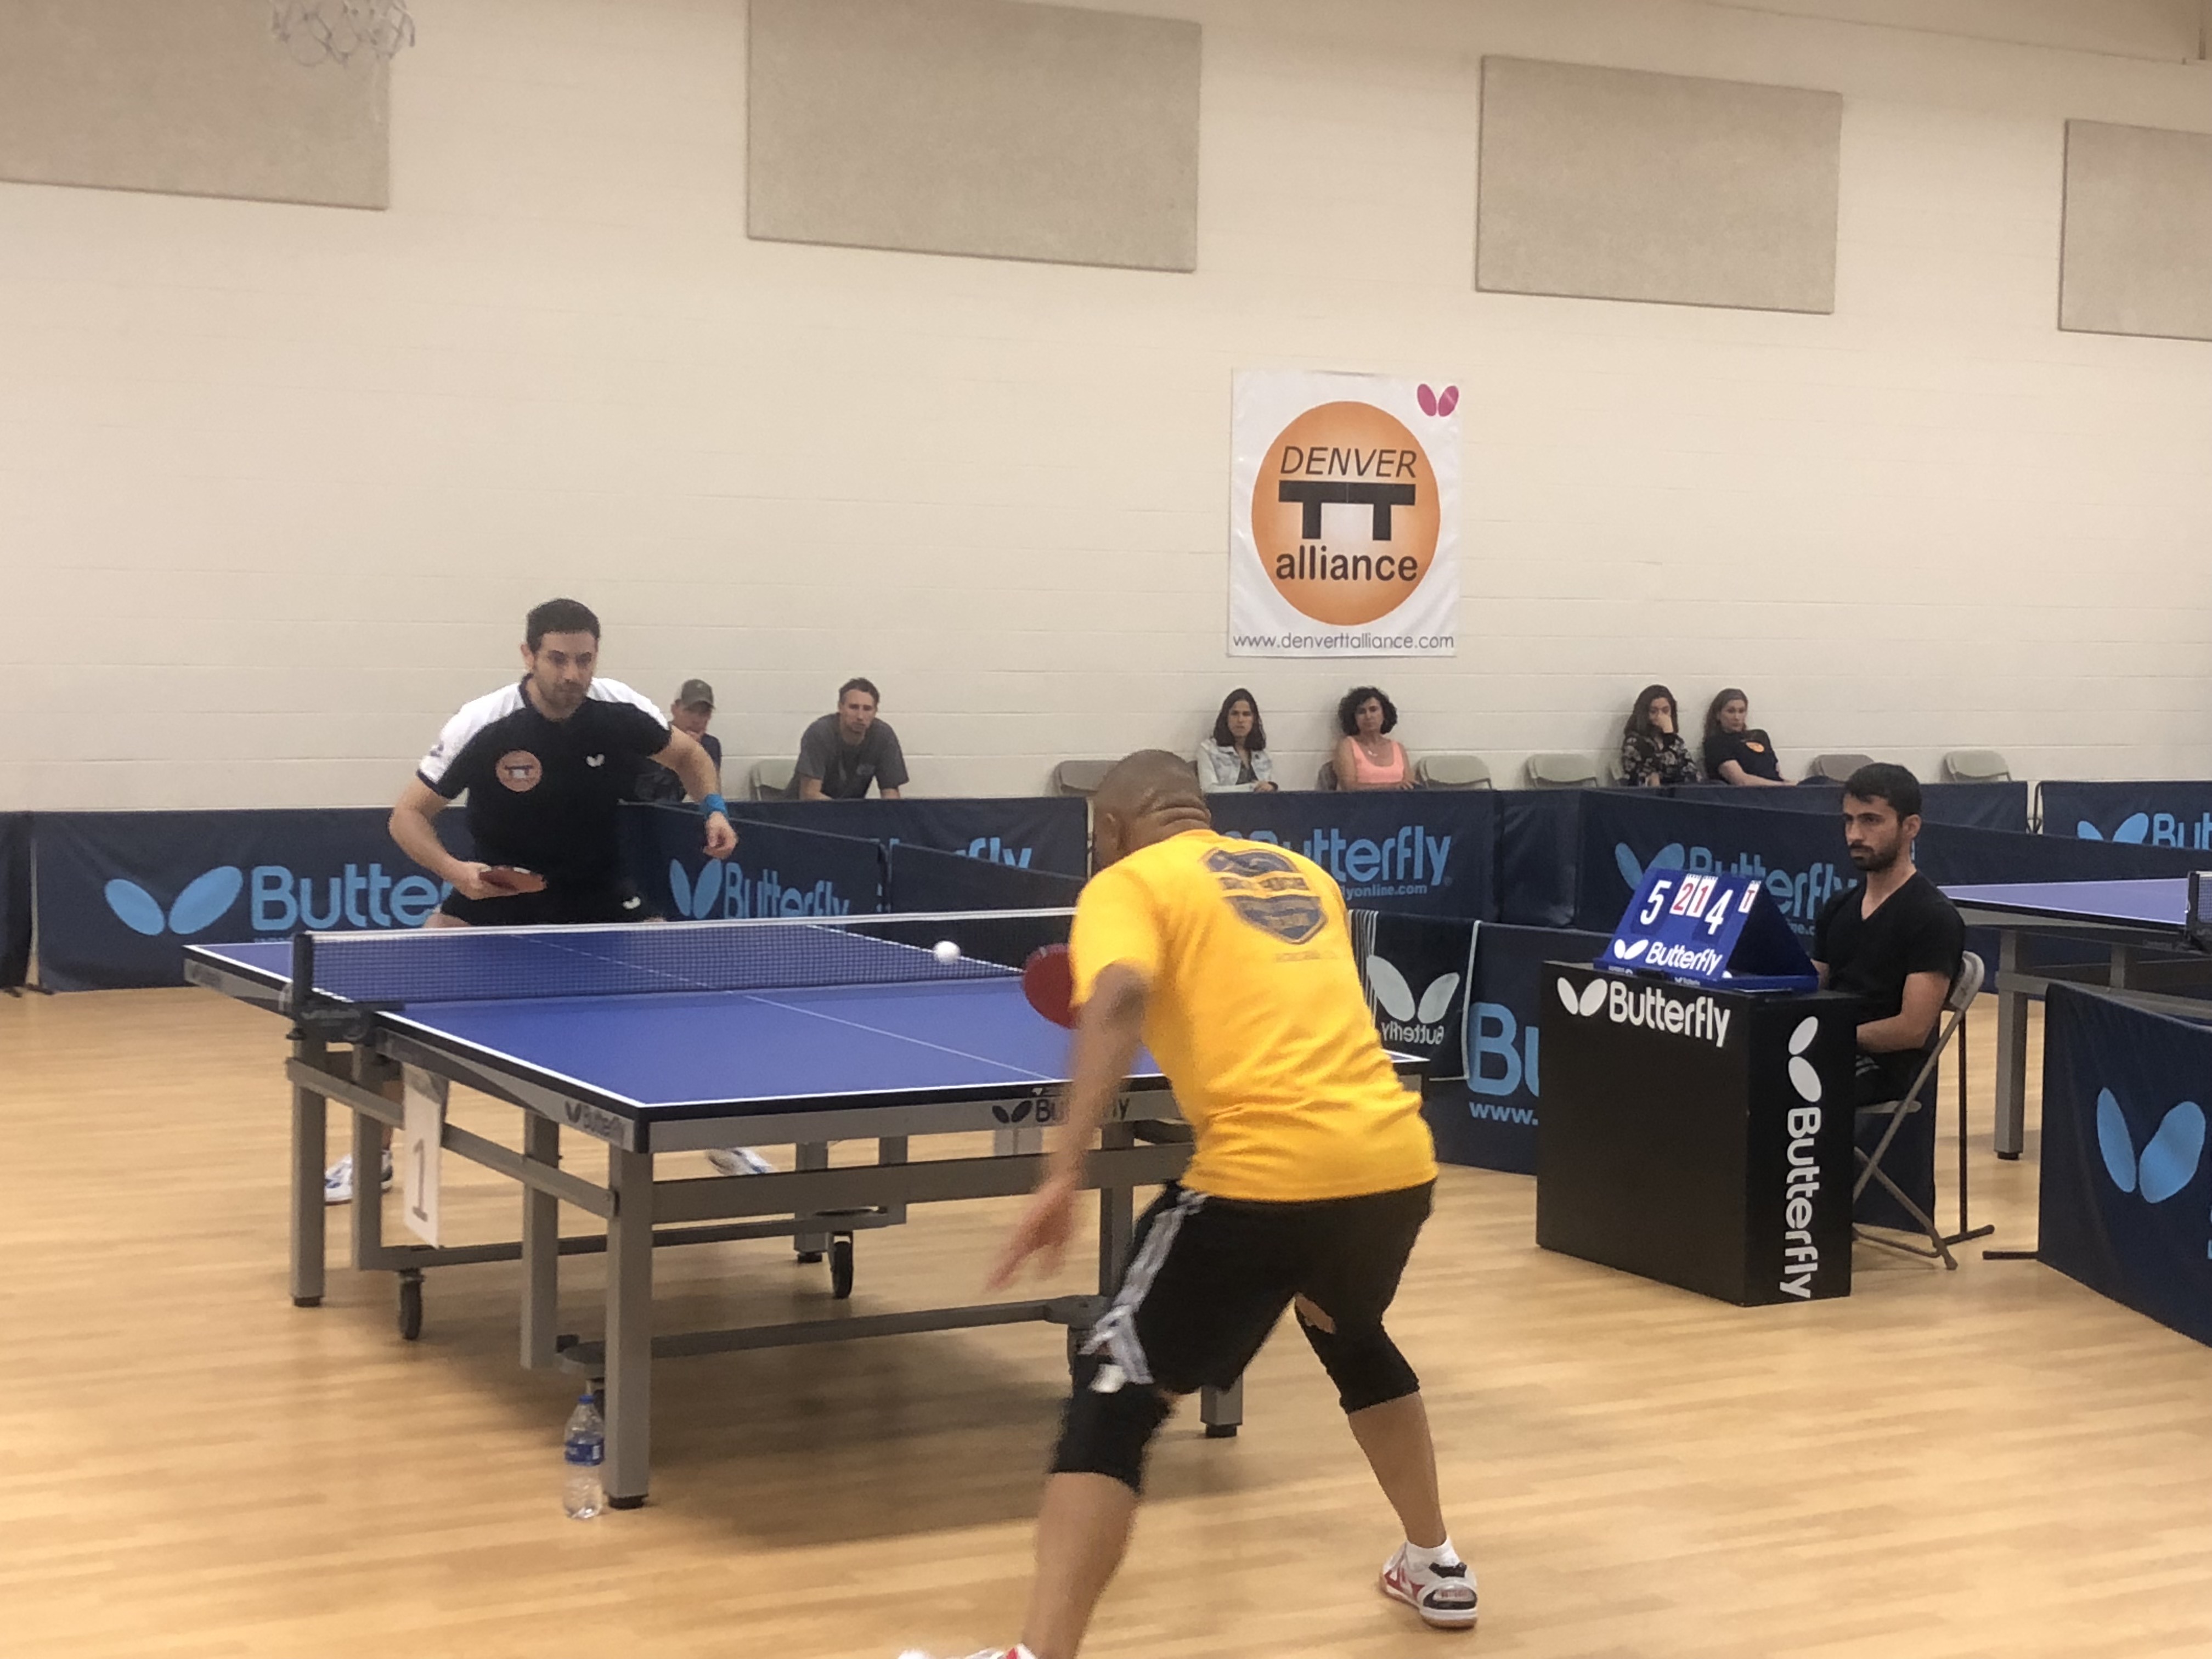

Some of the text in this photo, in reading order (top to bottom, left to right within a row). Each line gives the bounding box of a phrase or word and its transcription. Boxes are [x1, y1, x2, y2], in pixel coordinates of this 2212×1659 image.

[1280, 445, 1417, 478] DENVER
[1278, 479, 1416, 541] TT
[1276, 545, 1418, 582] alliance
[1233, 633, 1454, 650] www.denverttalliance.com
[1640, 879, 1672, 925] 5
[1704, 889, 1734, 935] 4
[1645, 941, 1723, 976] Butterfly
[1609, 981, 1731, 1048] Butterfly
[413, 1139, 427, 1222] 1
[1779, 1106, 1822, 1299] Butterfly
